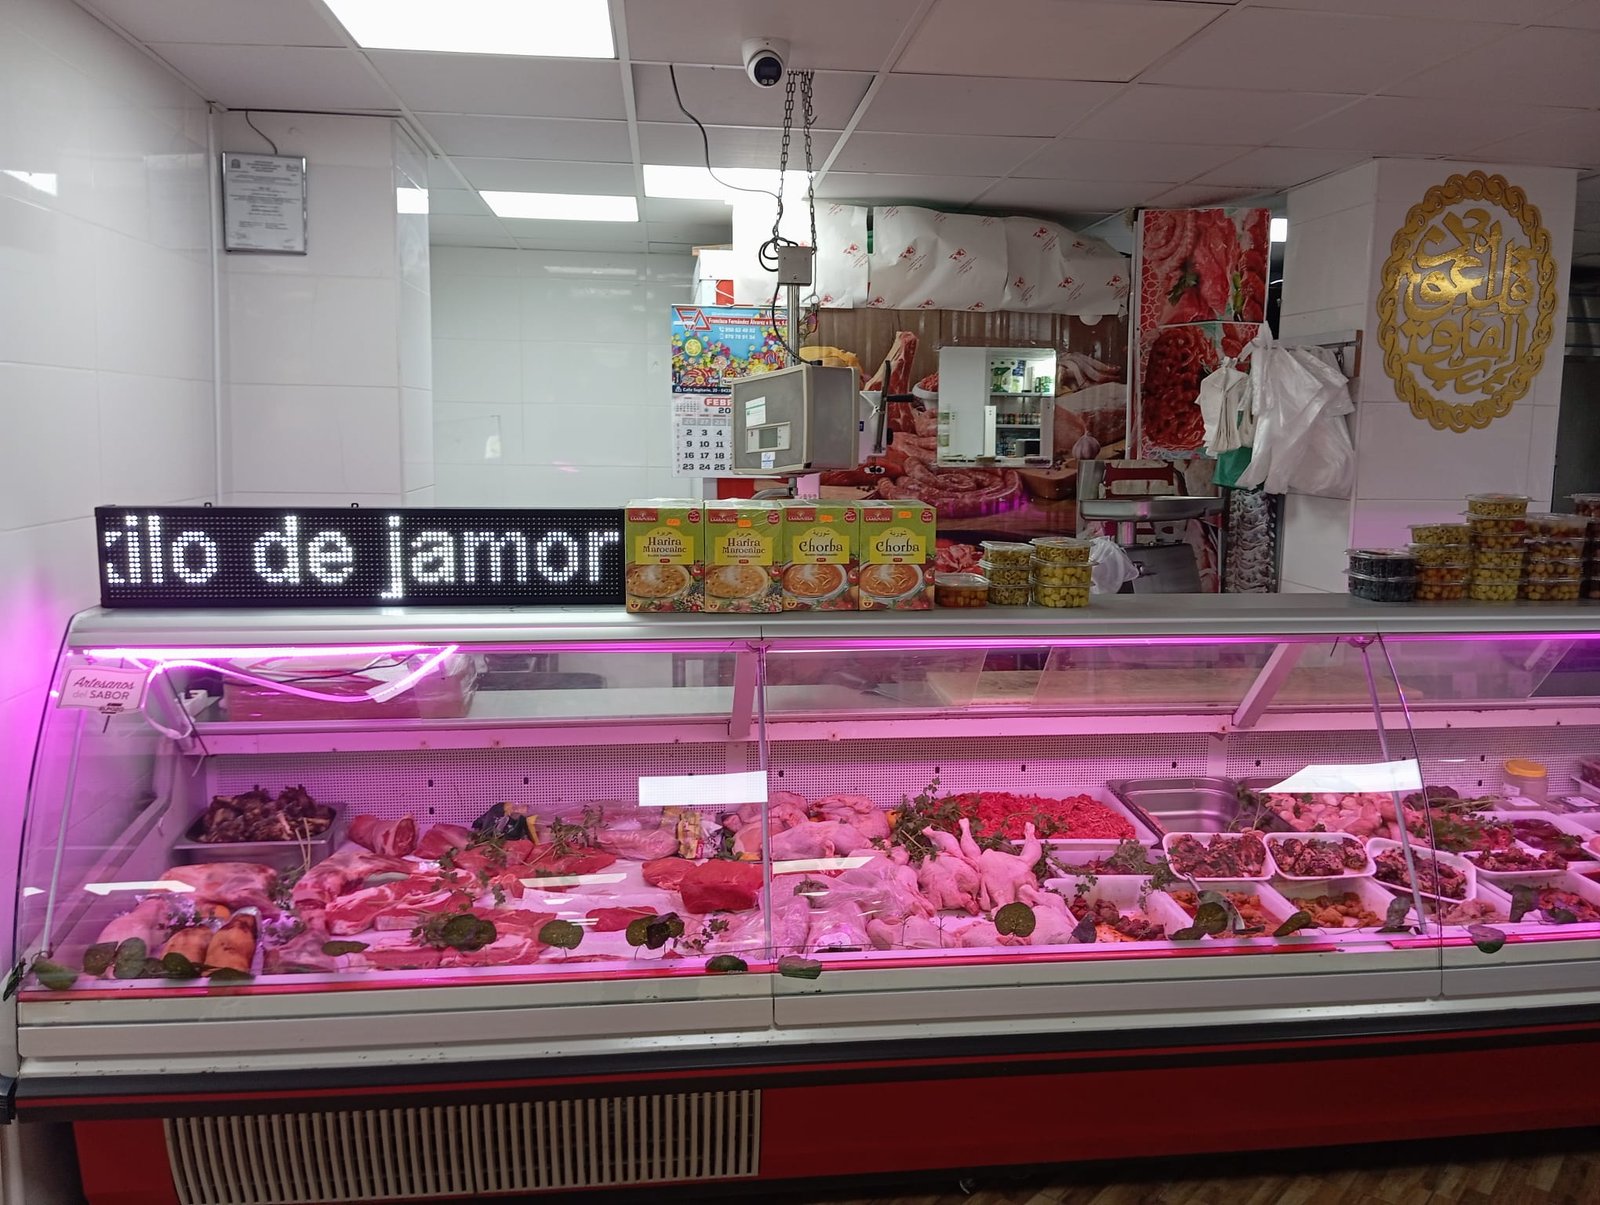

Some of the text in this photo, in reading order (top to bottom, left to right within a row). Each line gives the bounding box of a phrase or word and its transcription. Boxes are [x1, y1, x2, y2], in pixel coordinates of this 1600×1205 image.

[648, 536, 682, 546] Harira
[727, 537, 761, 547] Harira
[799, 538, 843, 553] Chorba
[875, 538, 920, 553] Chorba
[252, 514, 354, 584] de
[643, 545, 687, 553] Marocaine
[722, 546, 766, 554] Marocaine
[73, 676, 134, 690] Artesanos
[89, 690, 130, 700] SABOR
